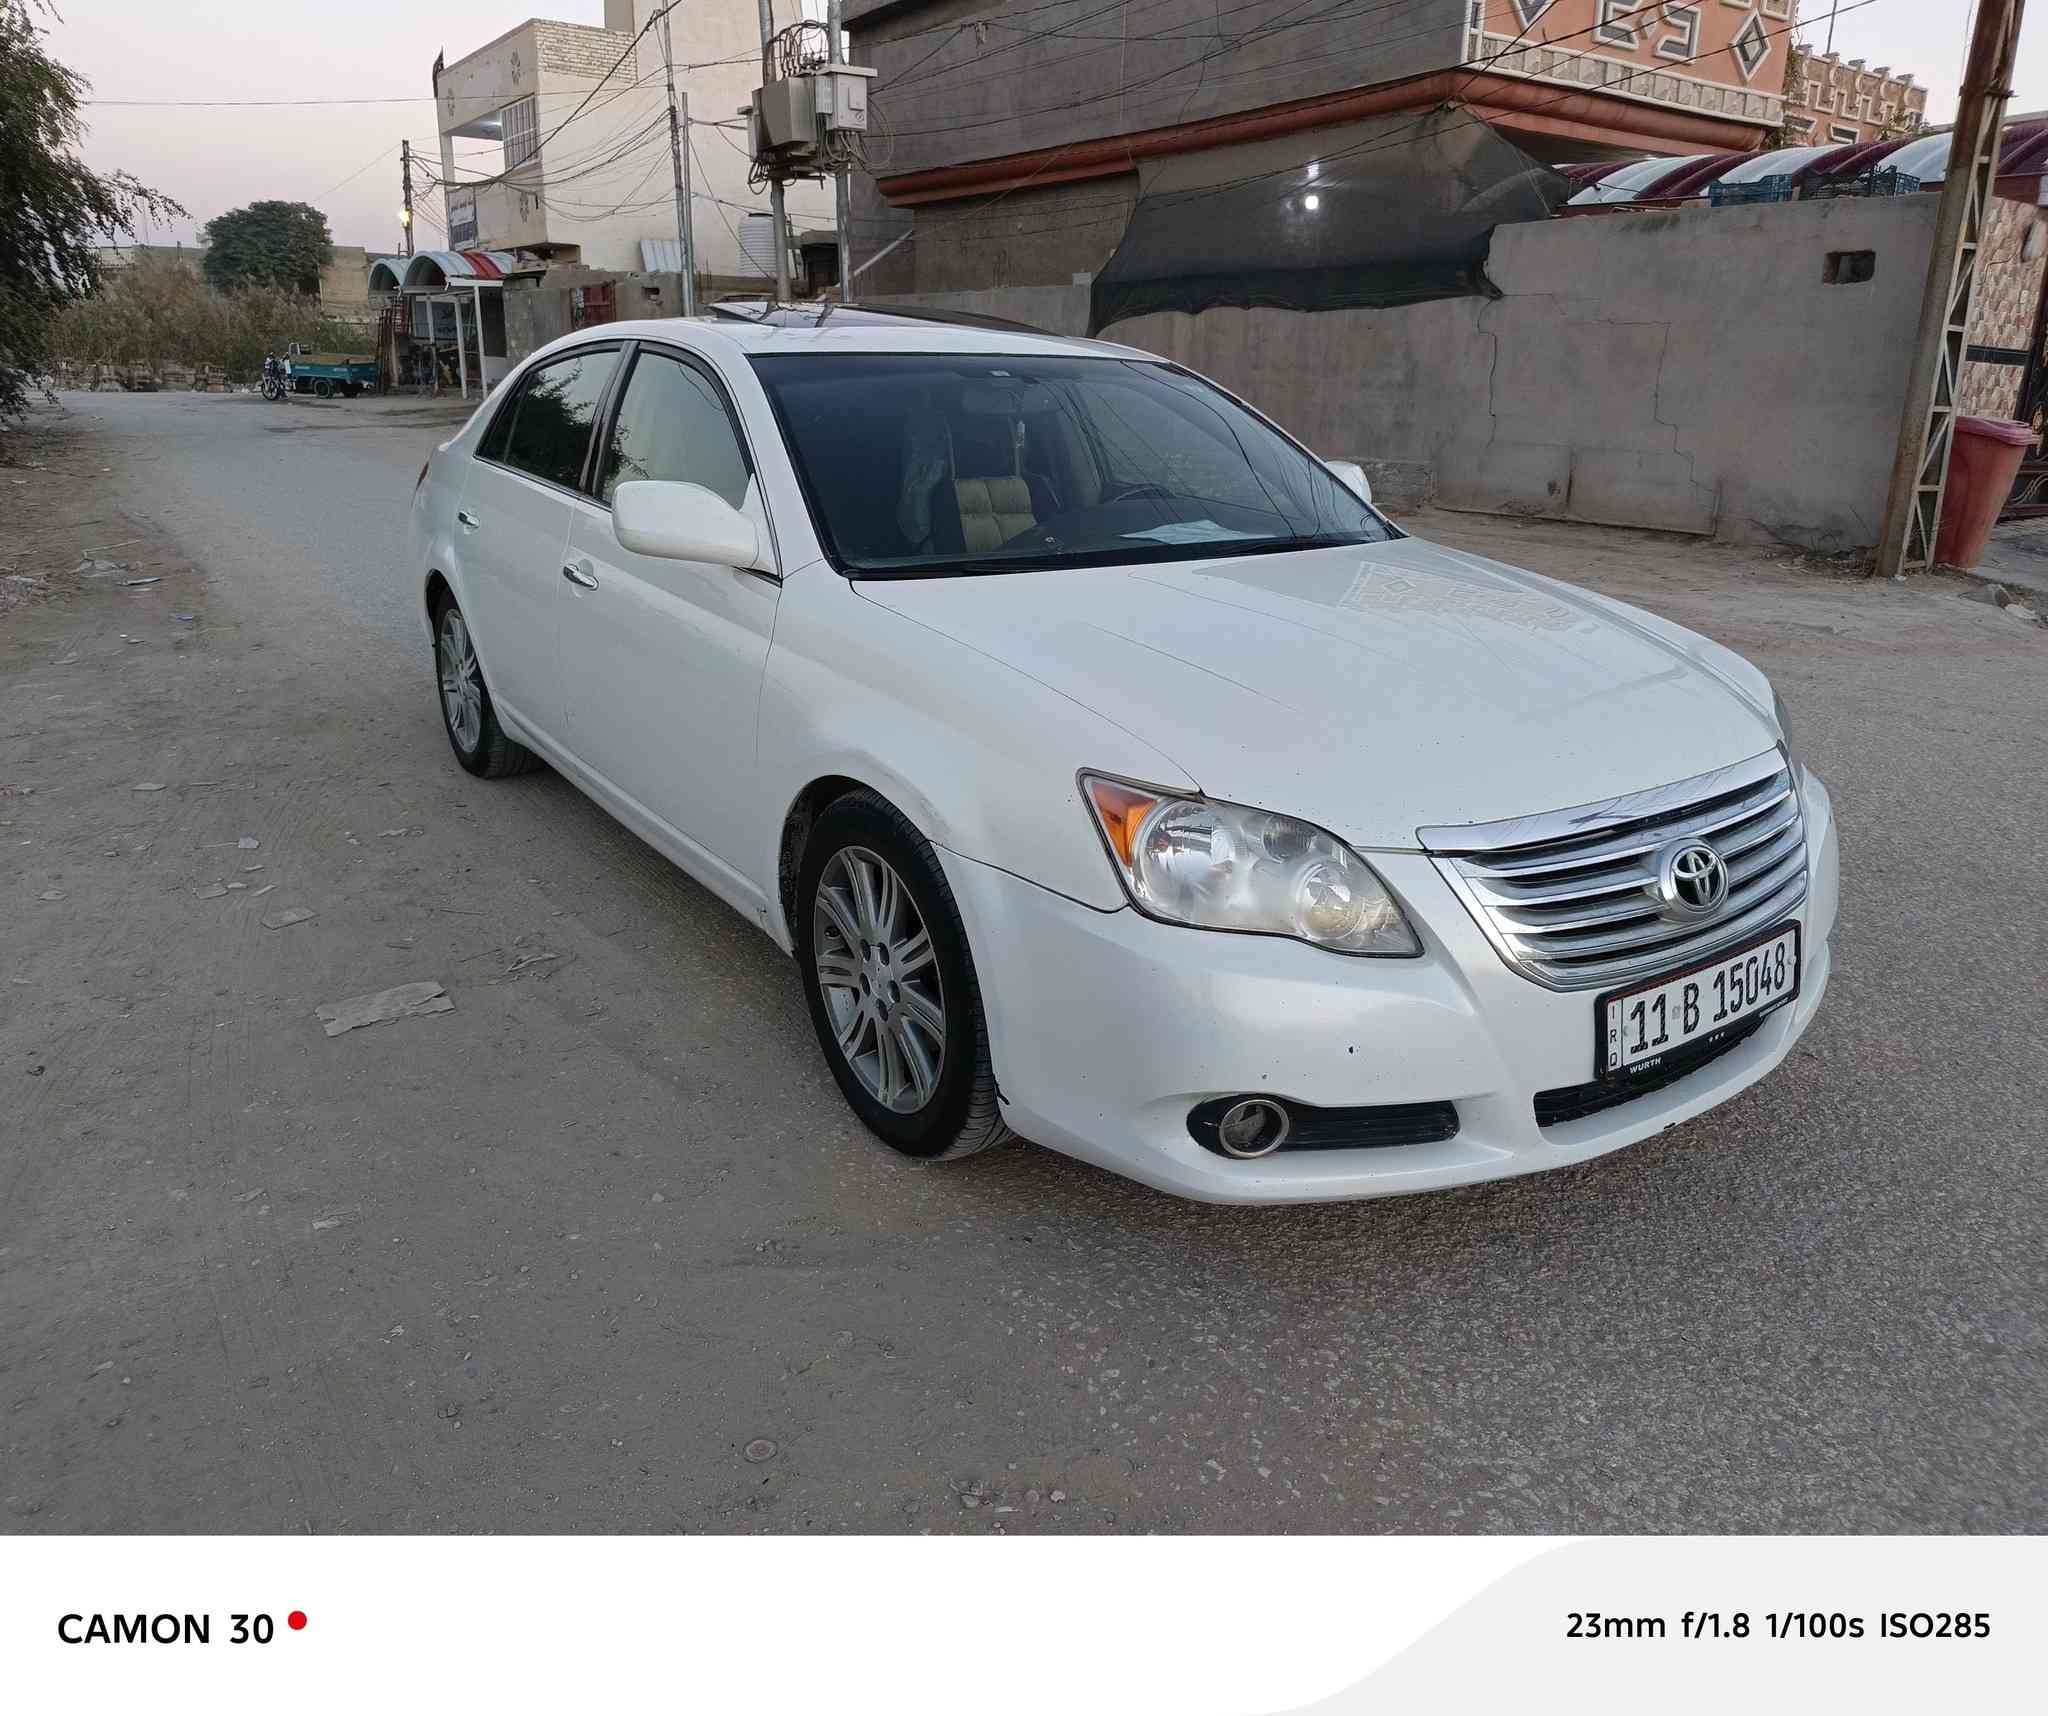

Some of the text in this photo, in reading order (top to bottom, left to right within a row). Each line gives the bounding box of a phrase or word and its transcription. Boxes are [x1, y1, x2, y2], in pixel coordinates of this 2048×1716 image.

[1629, 941, 1786, 1055] 11 B 15048
